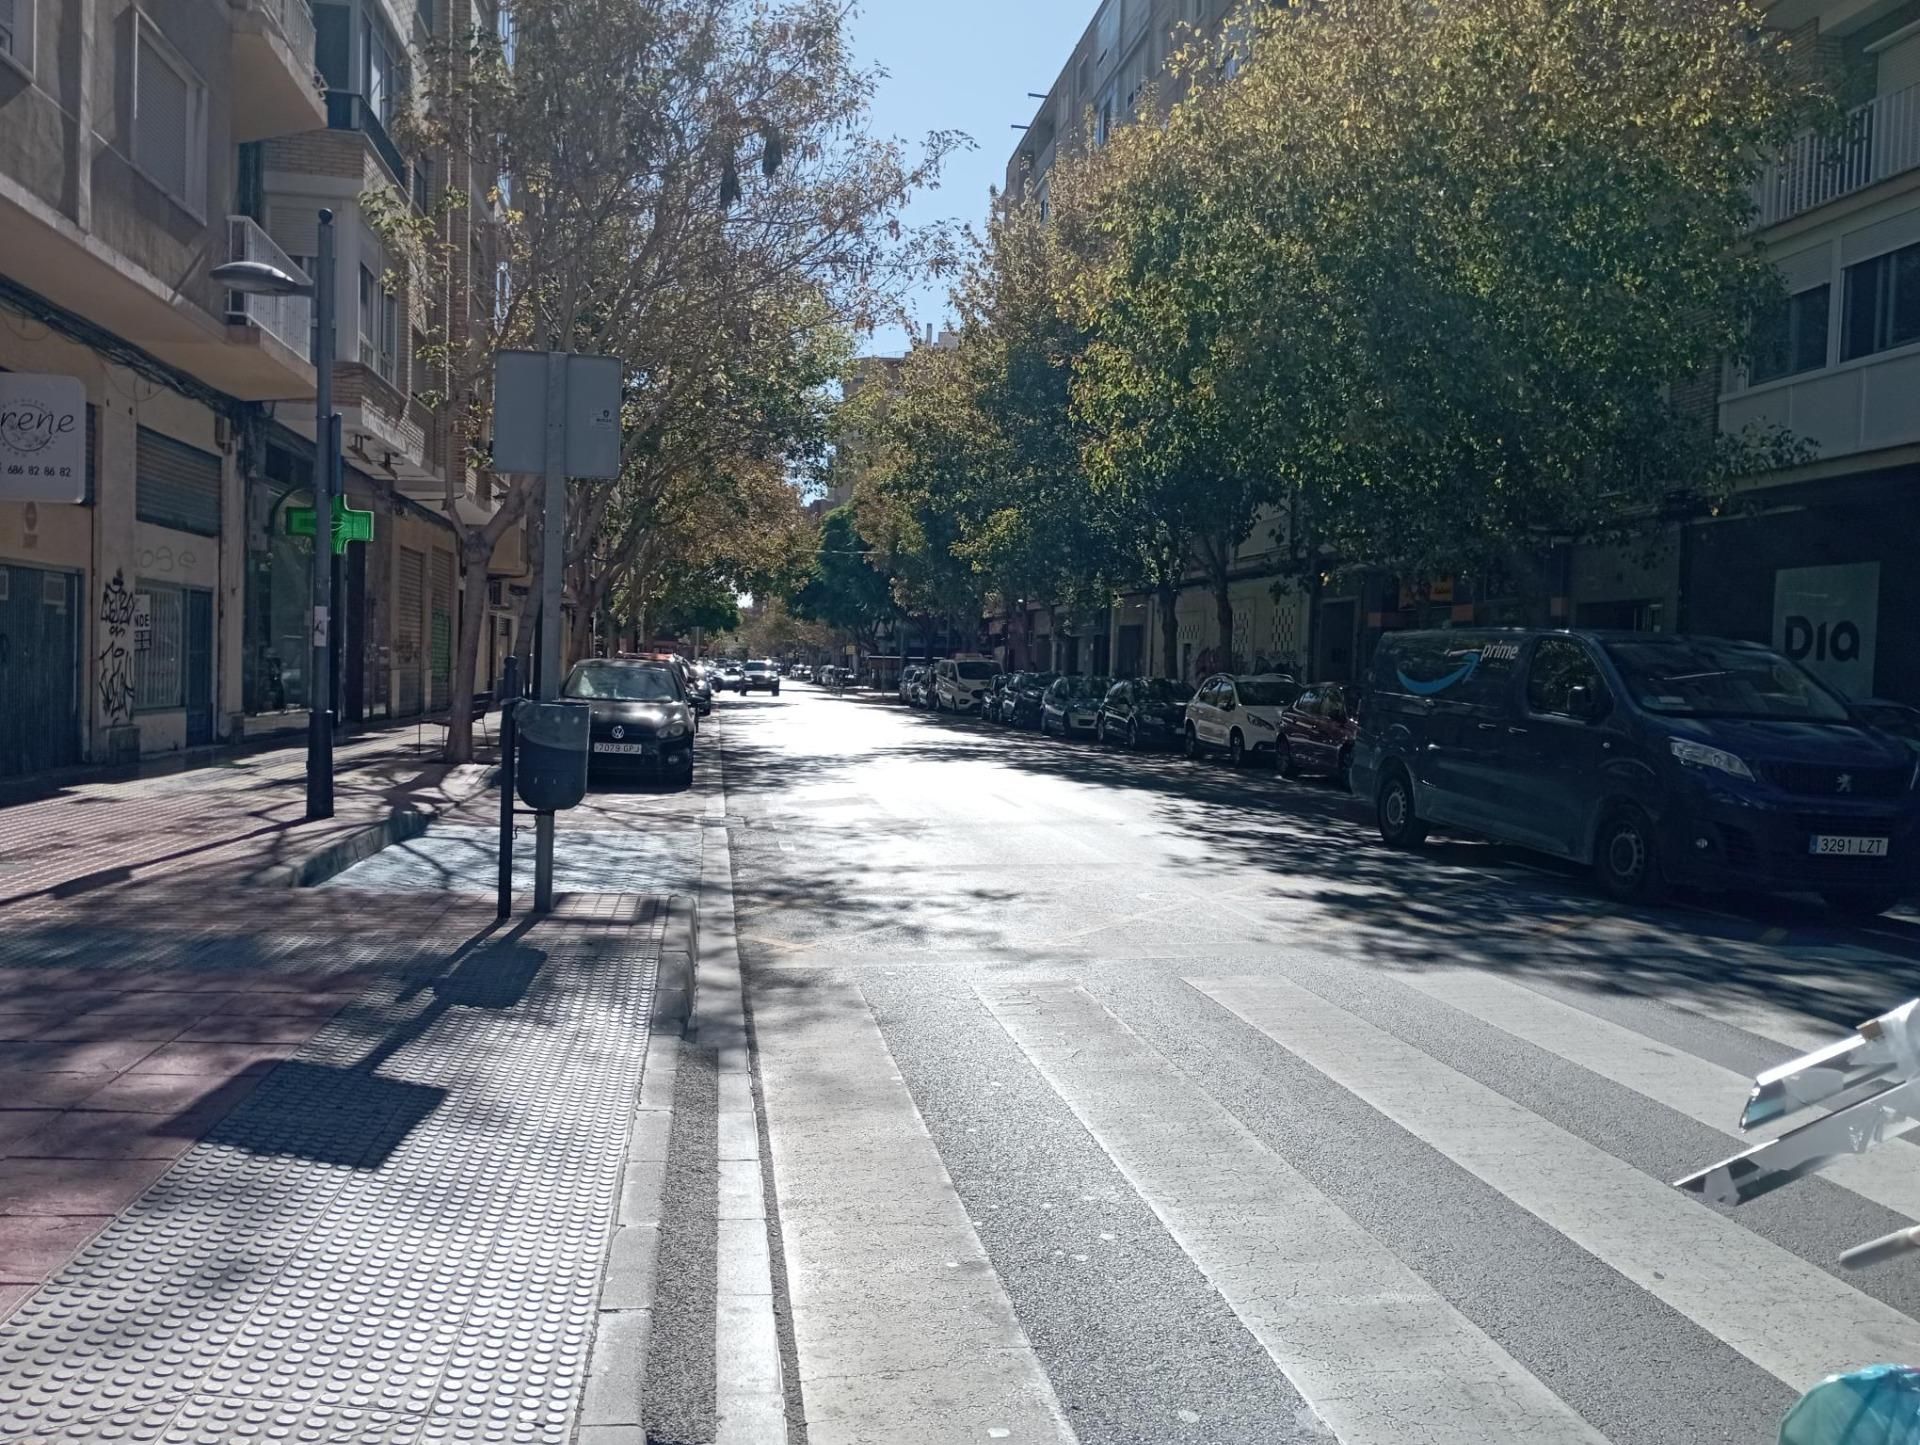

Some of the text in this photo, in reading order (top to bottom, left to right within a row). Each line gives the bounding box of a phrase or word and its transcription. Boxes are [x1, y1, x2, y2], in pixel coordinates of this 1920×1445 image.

[8, 465, 71, 478] 686 82 86 82
[1480, 640, 1519, 661] prime
[1821, 838, 1882, 855] 3291 LZT
